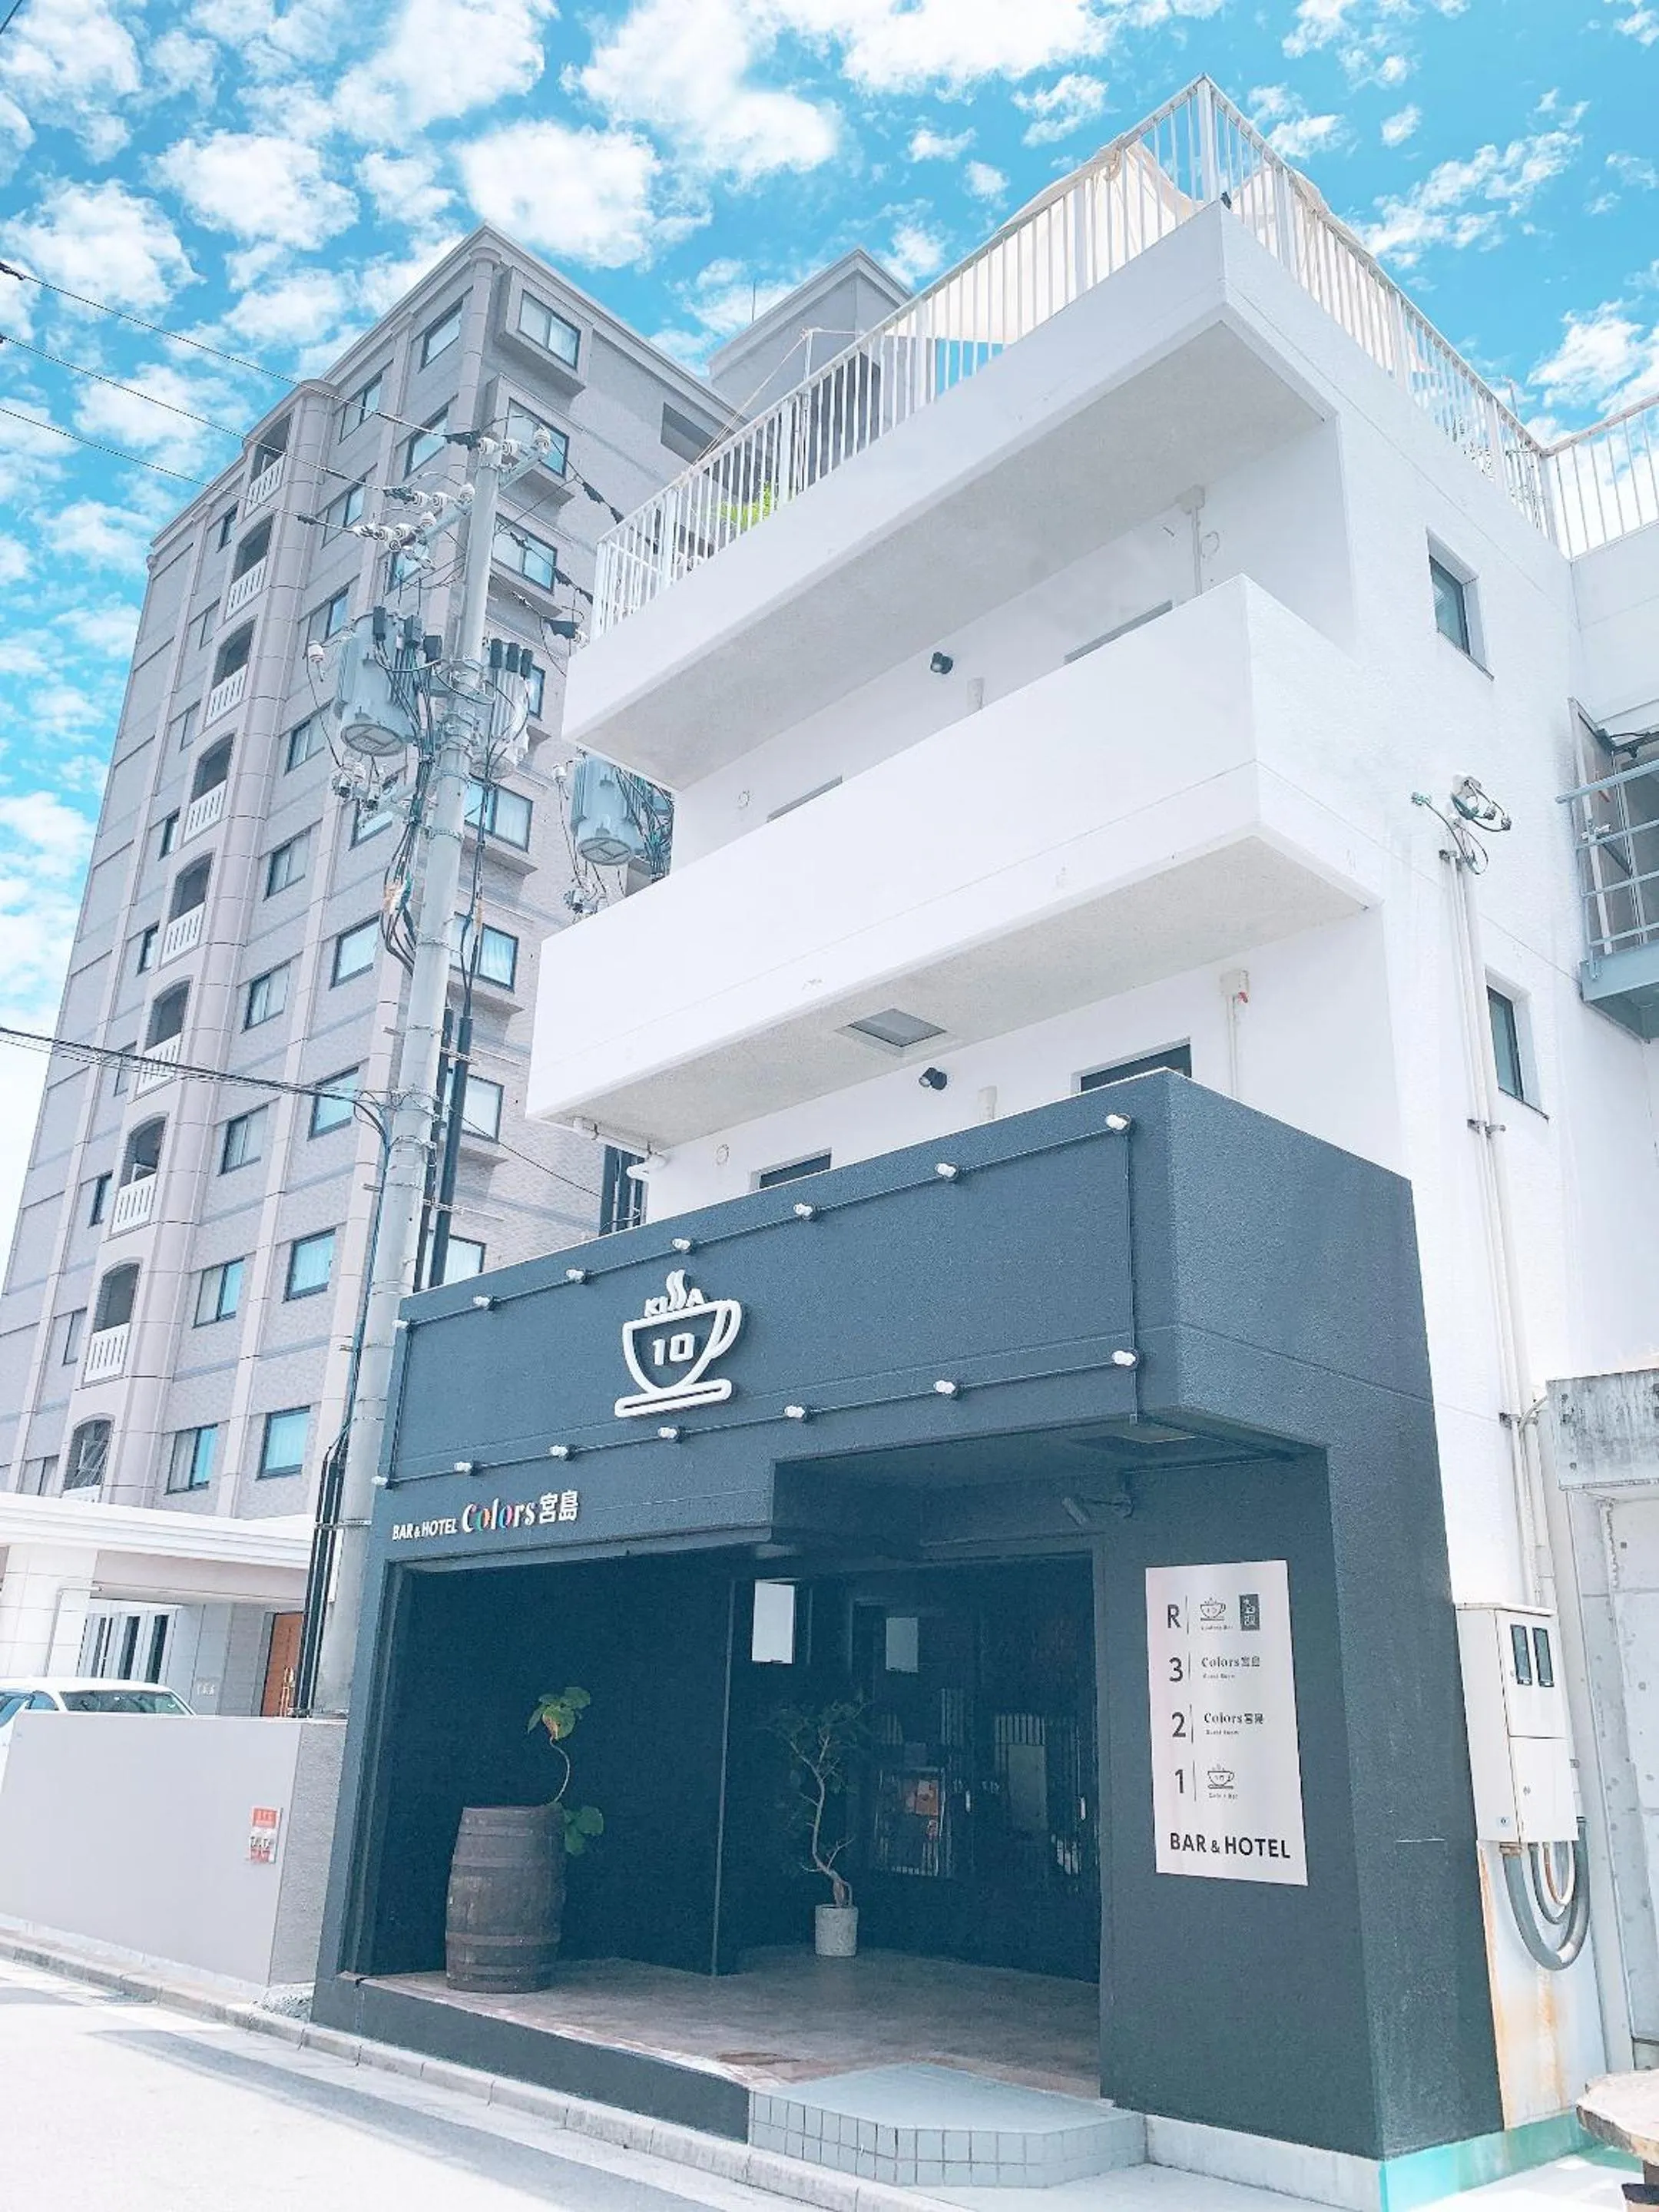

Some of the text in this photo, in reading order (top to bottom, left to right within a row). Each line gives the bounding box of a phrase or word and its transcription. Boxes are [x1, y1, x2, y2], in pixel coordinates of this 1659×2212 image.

[653, 1333, 695, 1366] 10
[392, 1524, 413, 1540] BAR
[422, 1518, 458, 1537] HOTEL
[1167, 1604, 1182, 1629] R
[1169, 1657, 1184, 1683] 3
[1172, 1711, 1187, 1738] 2
[1174, 1769, 1184, 1794] 1
[1170, 1832, 1291, 1859] BAR & HOTEL
